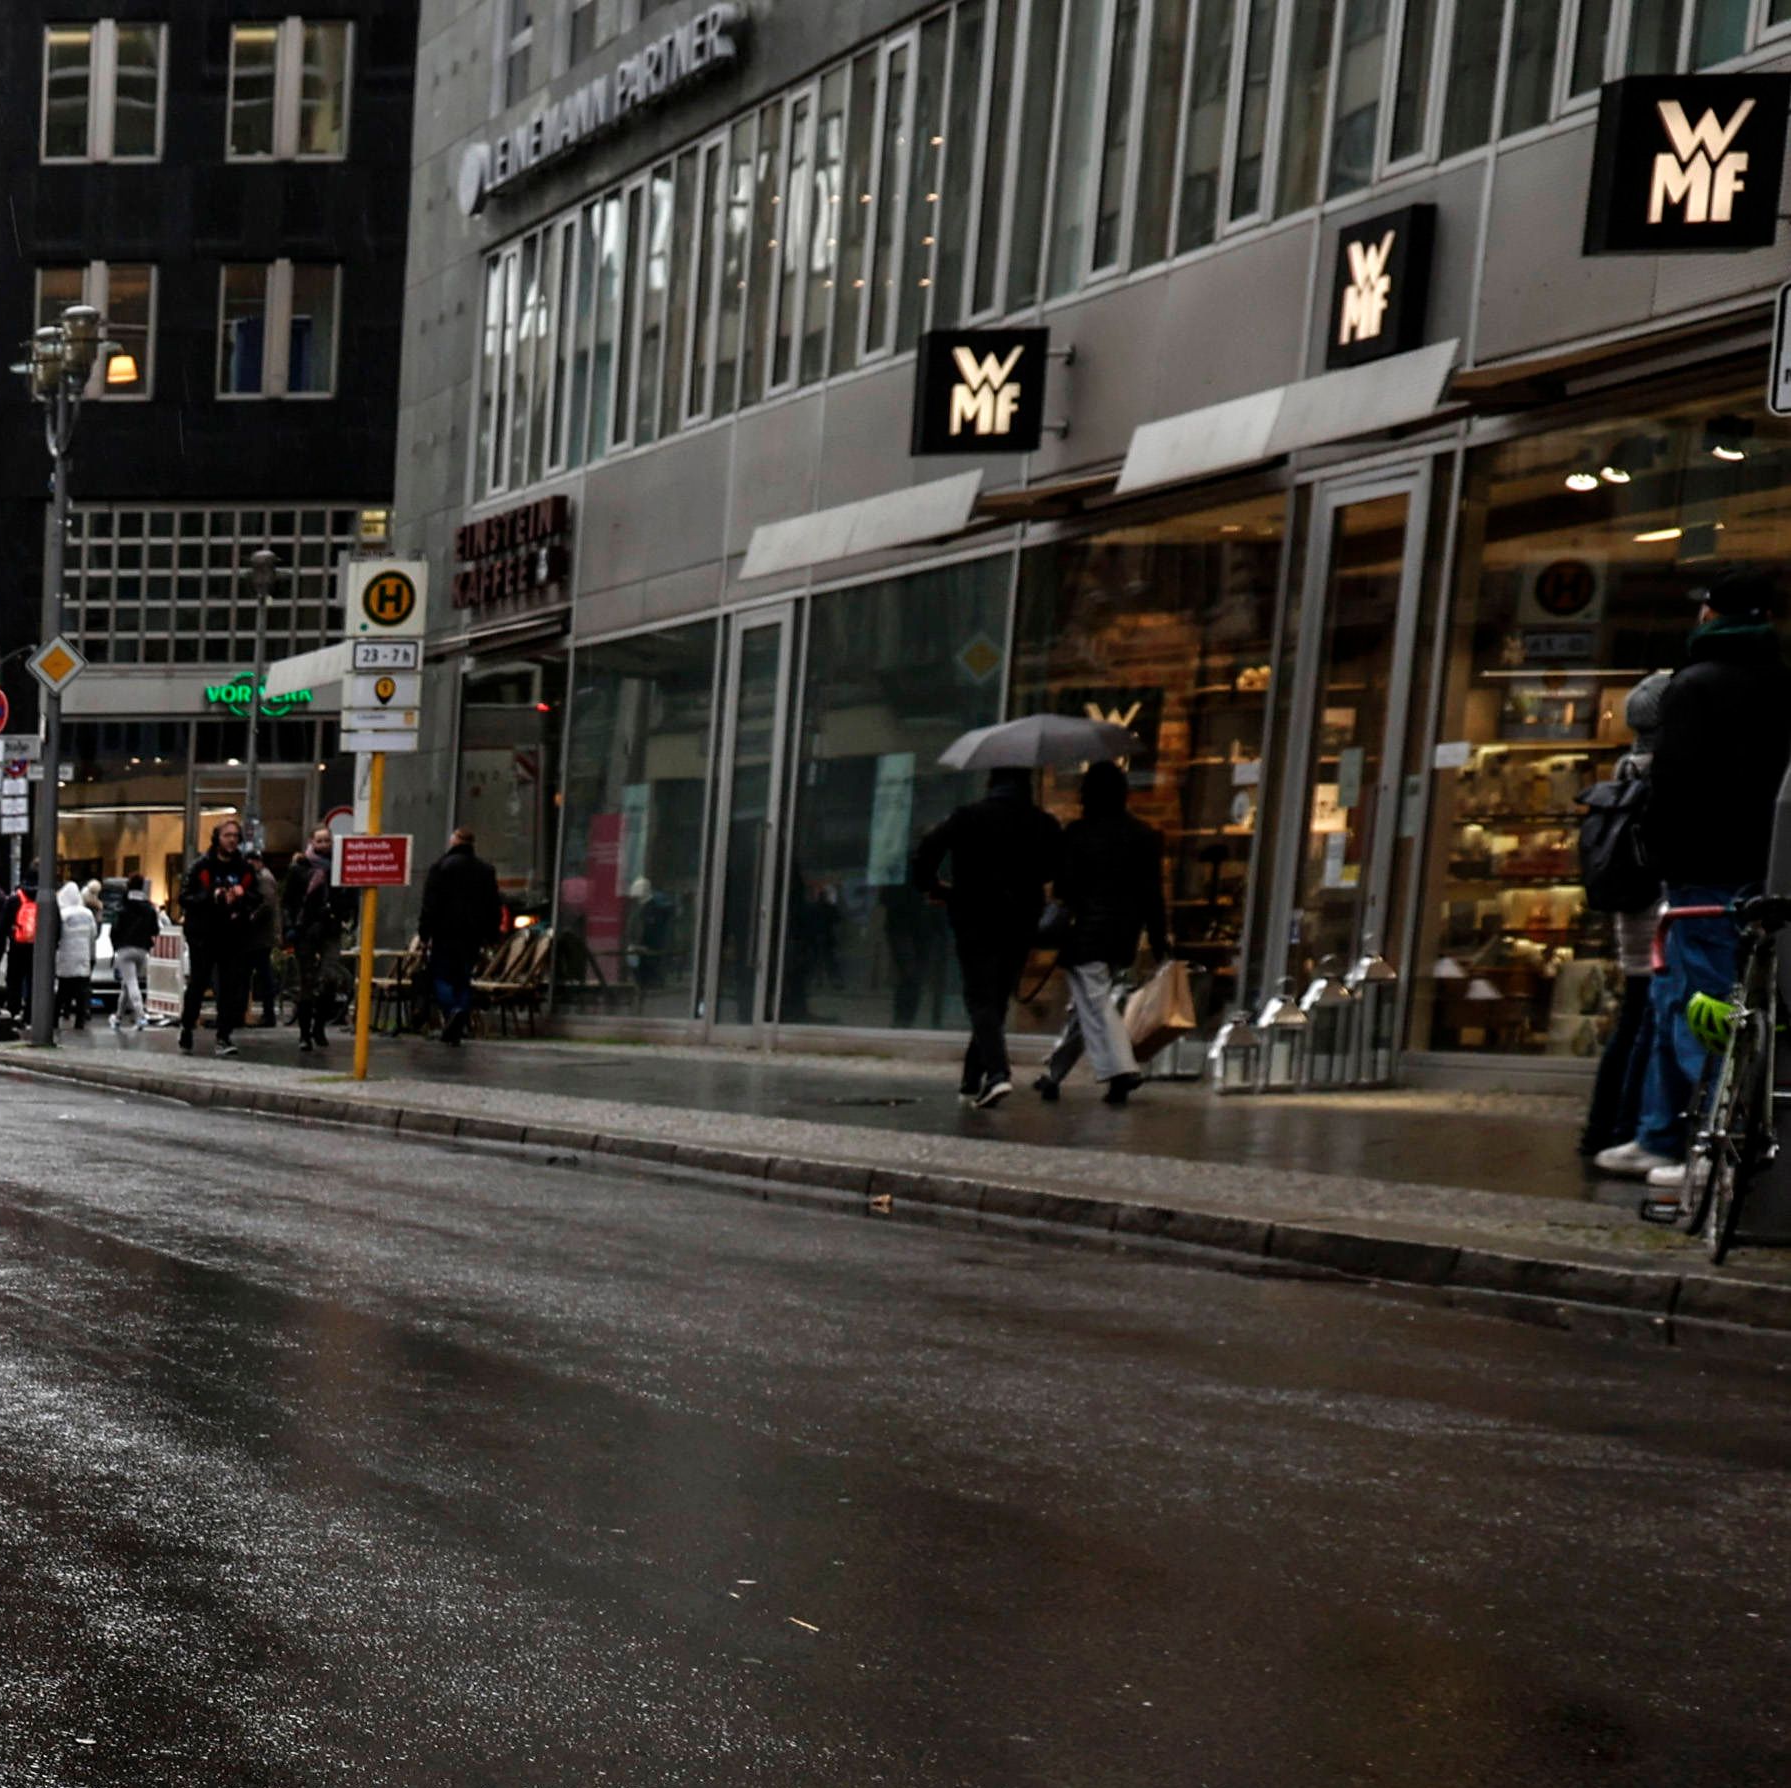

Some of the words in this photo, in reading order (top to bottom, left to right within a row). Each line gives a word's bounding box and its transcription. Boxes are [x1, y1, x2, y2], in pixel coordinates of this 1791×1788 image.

[616, 6, 735, 113] PARTNER
[1645, 97, 1757, 225] WMF
[1337, 229, 1397, 346] WMF
[948, 345, 1024, 437] WMF
[362, 649, 378, 663] 23
[392, 648, 400, 662] 7
[402, 648, 411, 662] h
